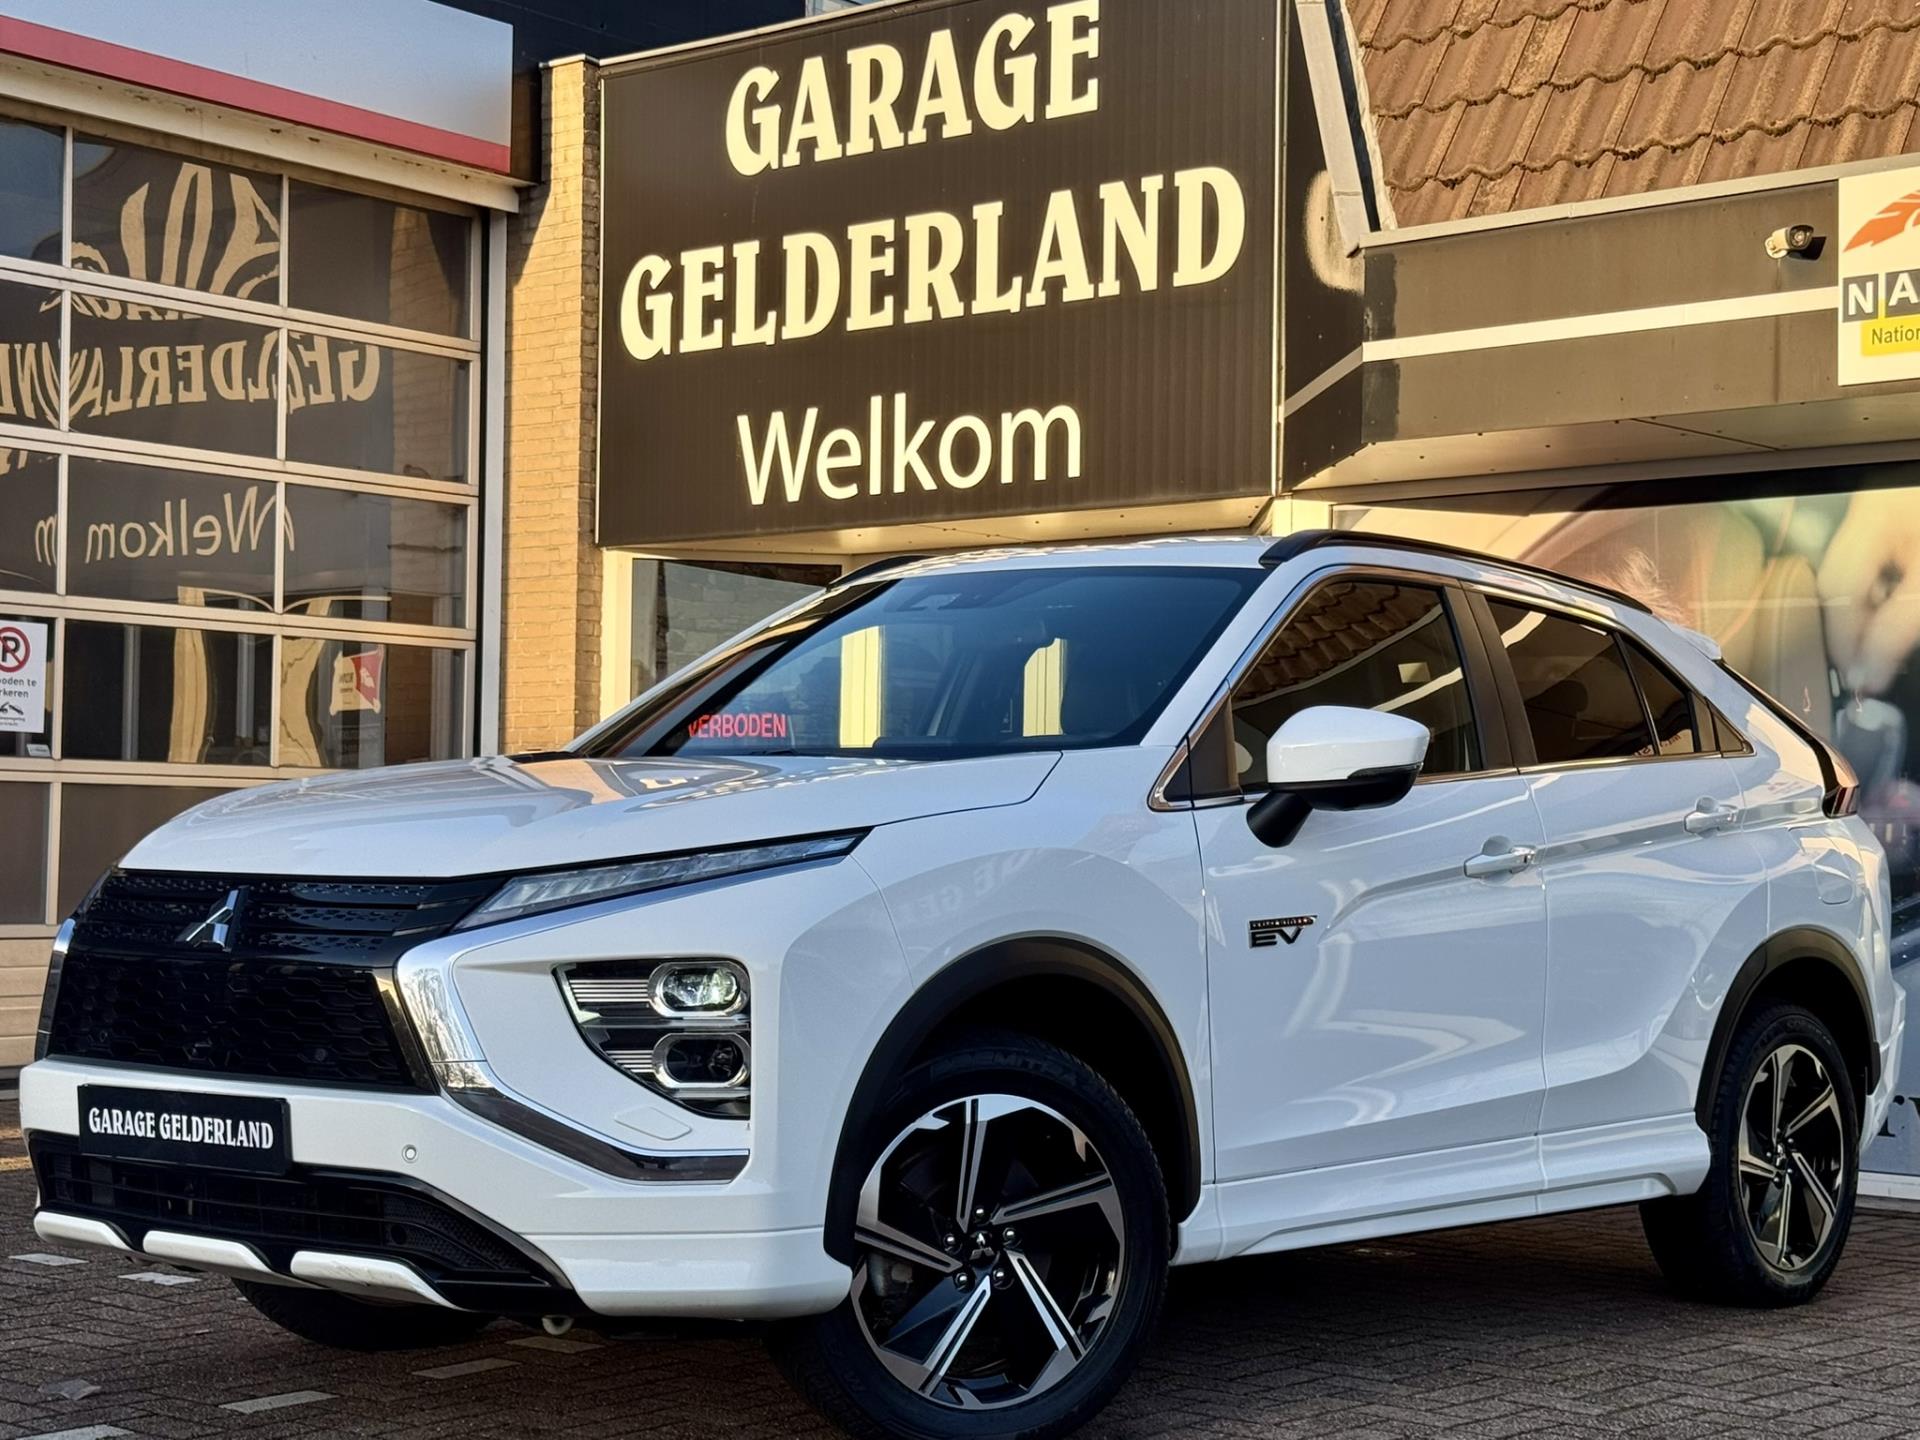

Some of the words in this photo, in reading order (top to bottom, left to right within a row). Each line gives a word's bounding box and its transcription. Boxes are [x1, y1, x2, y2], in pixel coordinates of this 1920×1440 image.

[726, 0, 1100, 177] GARAGE
[620, 166, 1247, 361] GELDERLAND
[737, 392, 1082, 505] Welkom
[0, 676, 24, 687] oden
[27, 678, 37, 687] te
[688, 713, 785, 738] VERBODEN
[1249, 927, 1303, 948] EV
[89, 1108, 156, 1138] GARAGE
[160, 1113, 274, 1149] GELDERLAND
